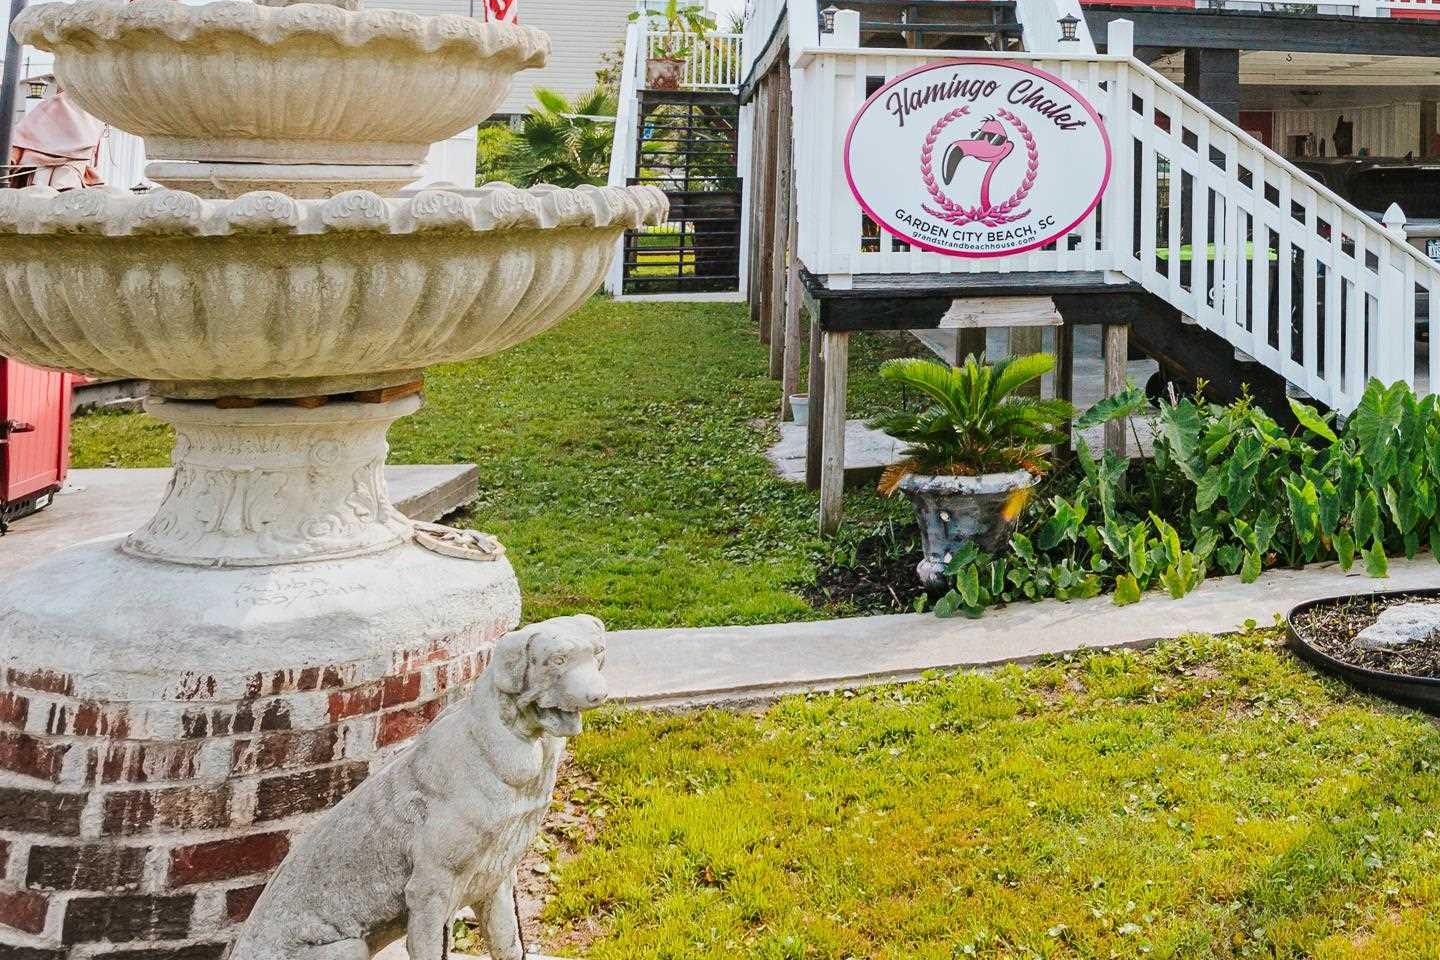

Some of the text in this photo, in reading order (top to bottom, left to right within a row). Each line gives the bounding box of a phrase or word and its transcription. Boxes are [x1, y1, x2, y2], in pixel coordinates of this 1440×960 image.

[886, 73, 1087, 131] Flamingo Chalet
[895, 208, 1056, 242] GARDEN CITY BEACH, SC
[912, 231, 1036, 250] grandstrandbeachhouse.com
